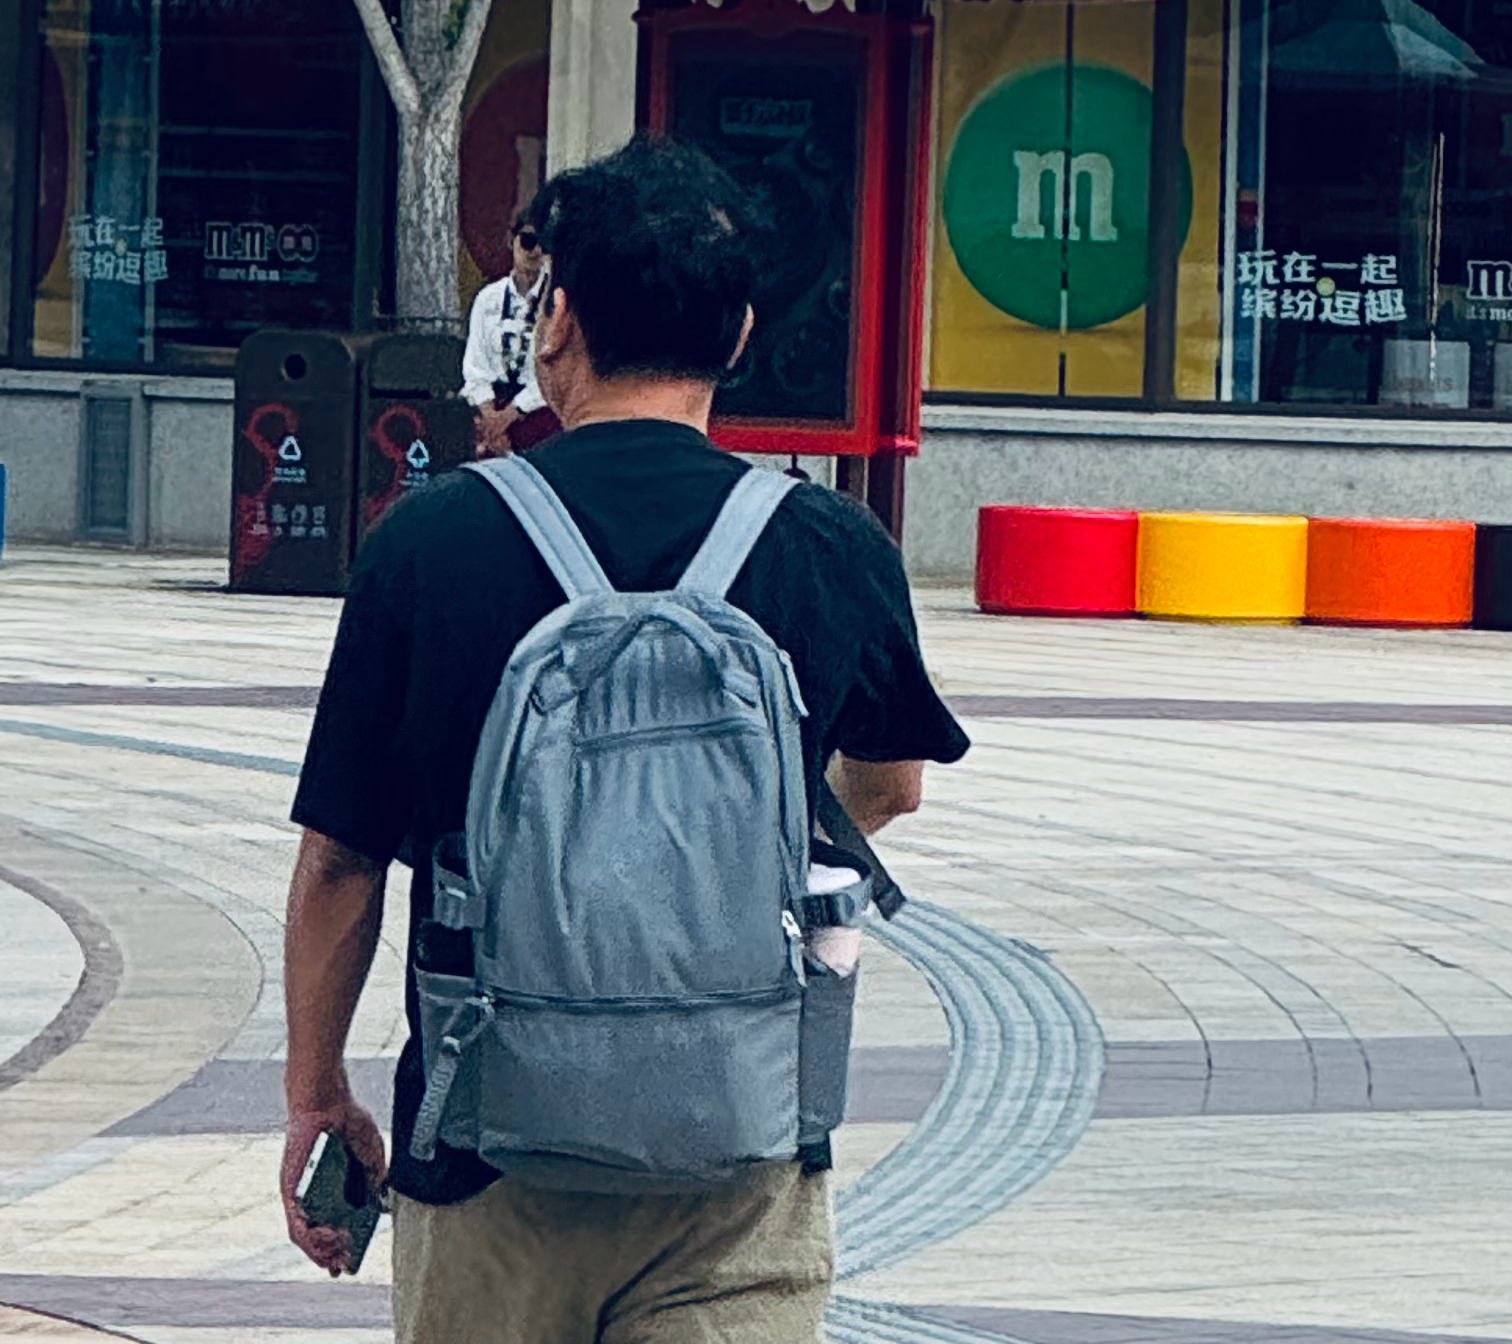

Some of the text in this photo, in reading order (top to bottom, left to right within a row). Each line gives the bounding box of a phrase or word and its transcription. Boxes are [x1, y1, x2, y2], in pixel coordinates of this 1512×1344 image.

[1237, 249, 1399, 285] 玩在一起
[1240, 287, 1408, 326] 缤纷逗趣
